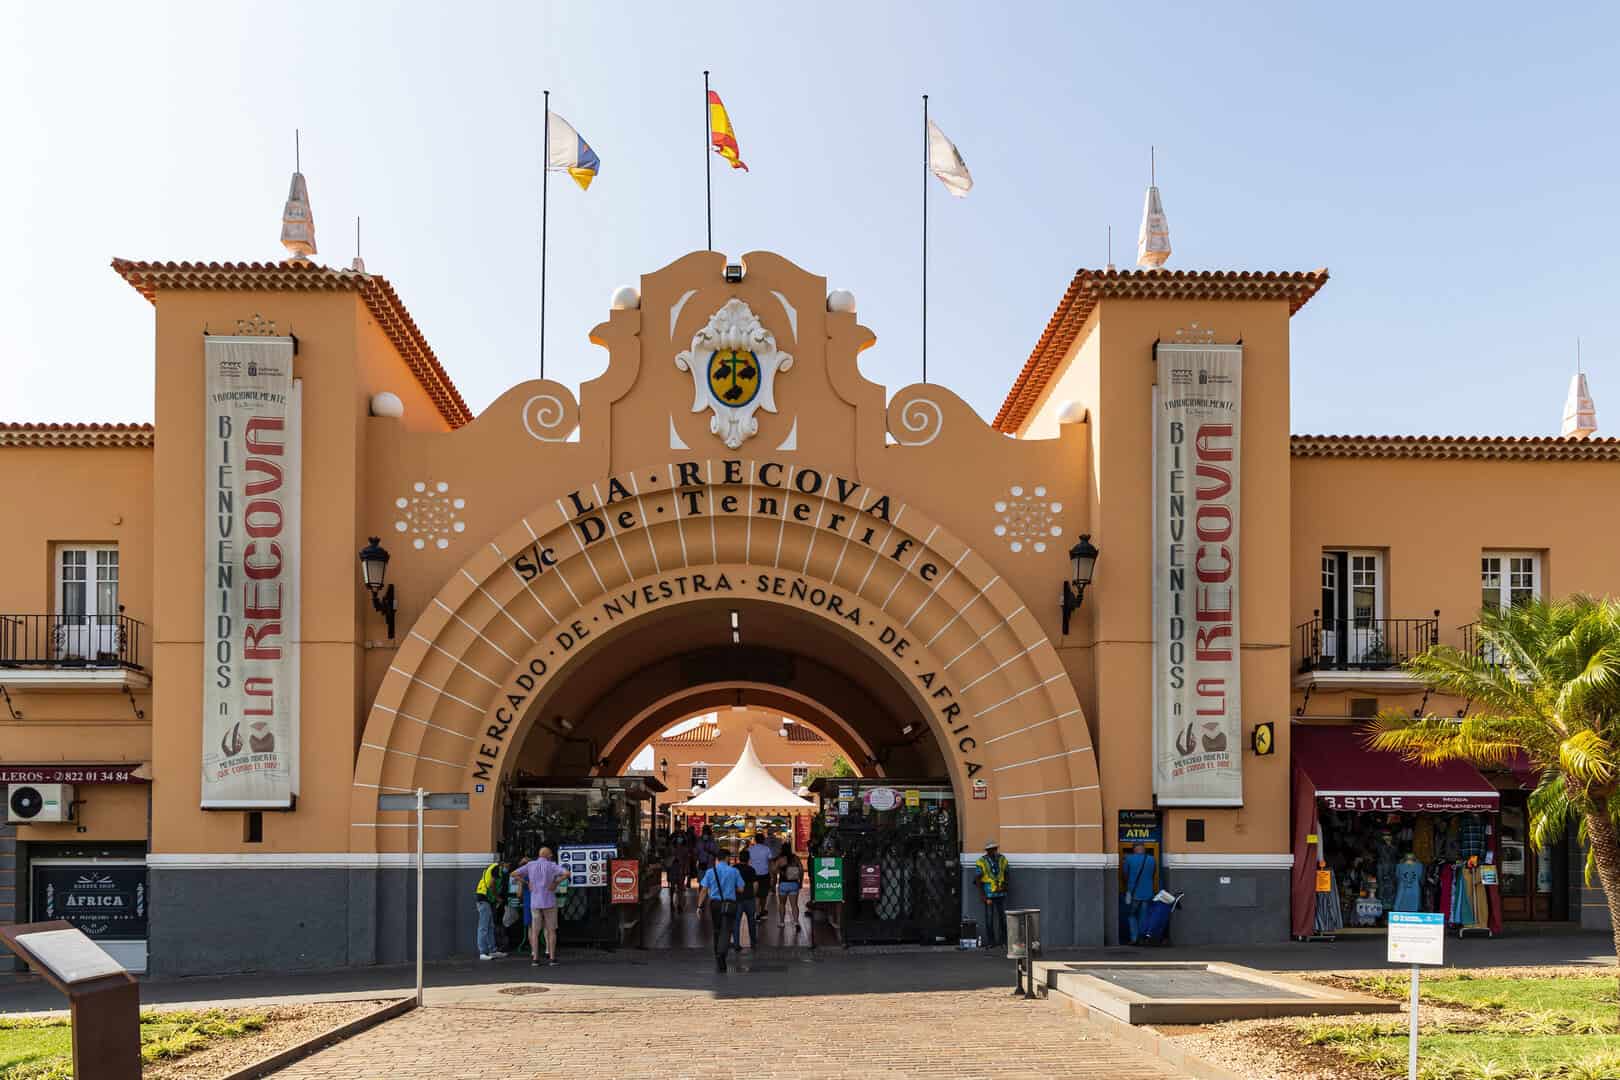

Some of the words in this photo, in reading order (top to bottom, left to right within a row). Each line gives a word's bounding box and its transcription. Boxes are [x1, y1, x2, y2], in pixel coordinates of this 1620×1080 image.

[217, 415, 233, 689] BIENVENIDOS
[243, 416, 285, 660] RECOVA
[568, 477, 633, 517] LA
[676, 460, 891, 524] RECOVA
[576, 511, 637, 546] De
[681, 490, 938, 582] Tenerife
[1169, 422, 1184, 689] BIENVENIDOS
[1196, 424, 1233, 661] RECOVA
[473, 658, 547, 781] MERCADO
[555, 620, 590, 651] DE
[603, 573, 733, 620] NVESTRA
[756, 574, 862, 626] SEÑORA
[878, 626, 910, 658] DE
[917, 671, 983, 779] AFRICA
[64, 772, 83, 781] 822
[86, 772, 97, 781] 01
[100, 772, 114, 781] 34
[116, 772, 129, 781] 84
[1126, 829, 1150, 838] ATM
[66, 893, 124, 906] ÁFRICA
